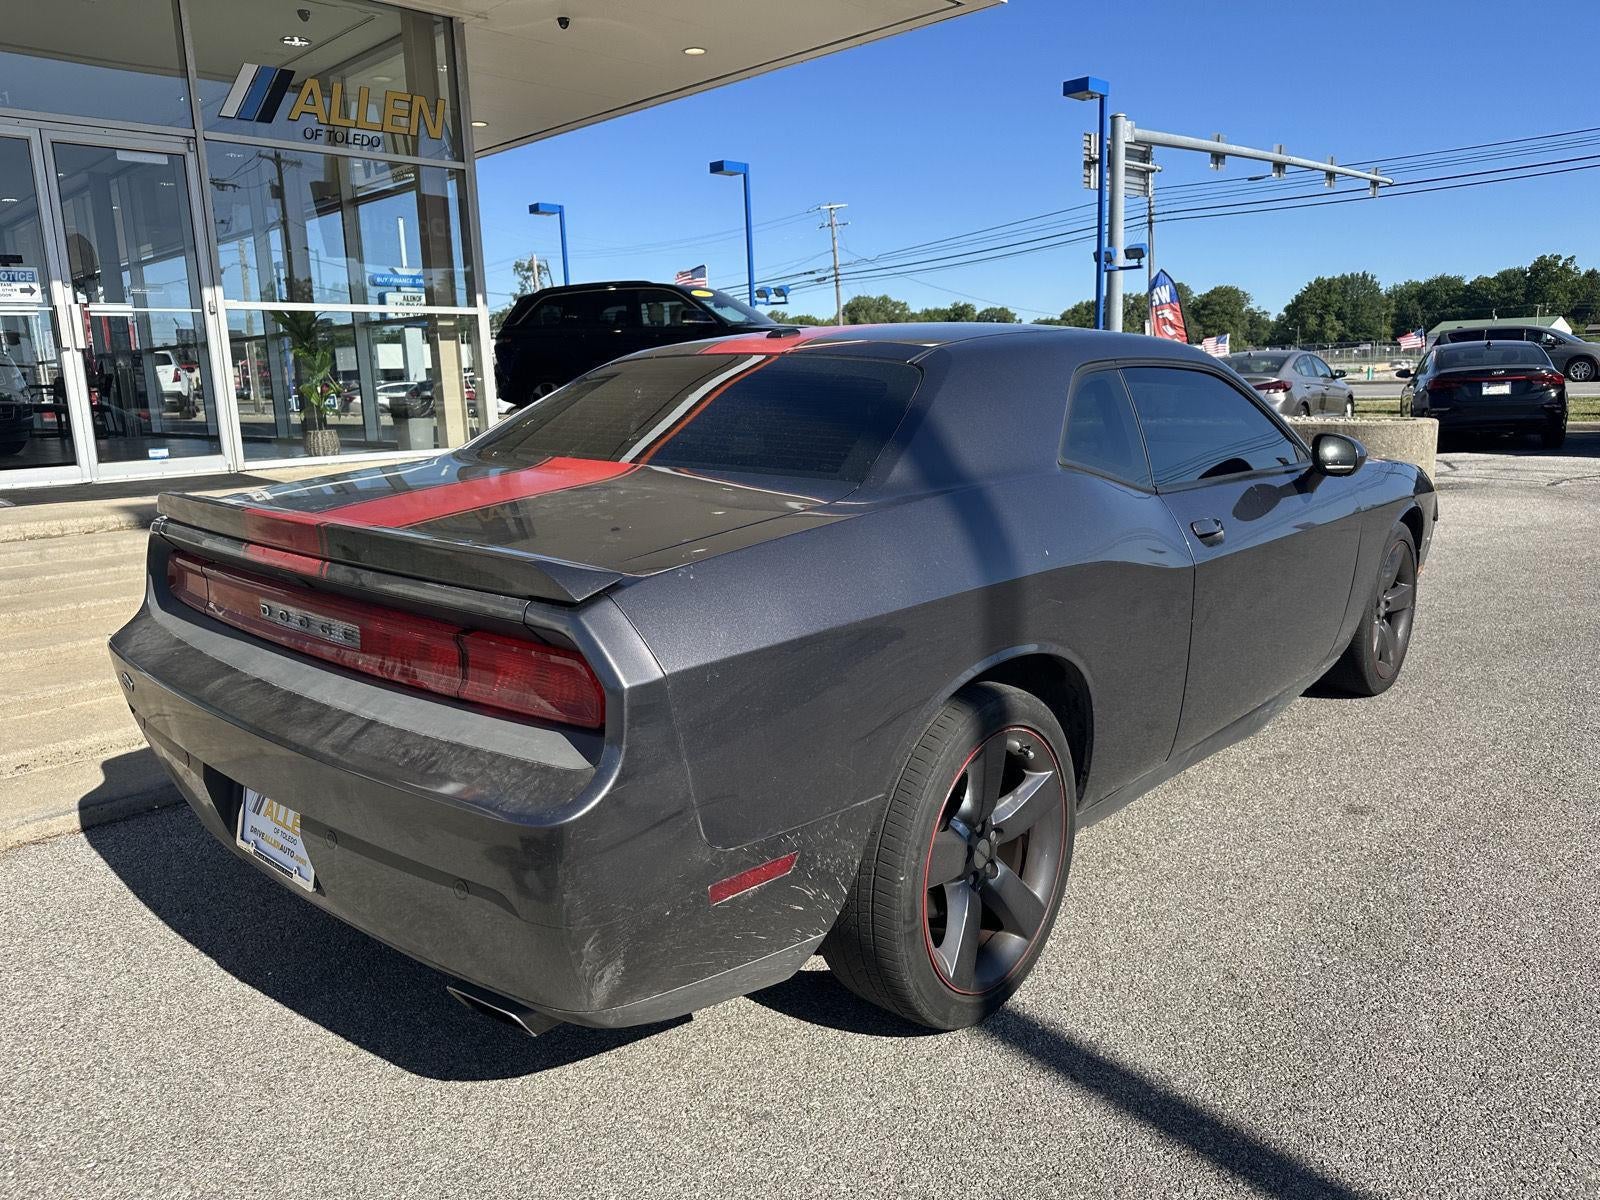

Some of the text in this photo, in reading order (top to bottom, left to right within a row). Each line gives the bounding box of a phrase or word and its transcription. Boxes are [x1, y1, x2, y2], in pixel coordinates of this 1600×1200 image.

[288, 78, 446, 140] ALLEN
[303, 127, 381, 148] OF TOLEDO
[0, 271, 33, 281] OTICE
[260, 603, 358, 641] DODGE
[263, 799, 301, 838] ALLE
[280, 831, 298, 846] TOLEDO
